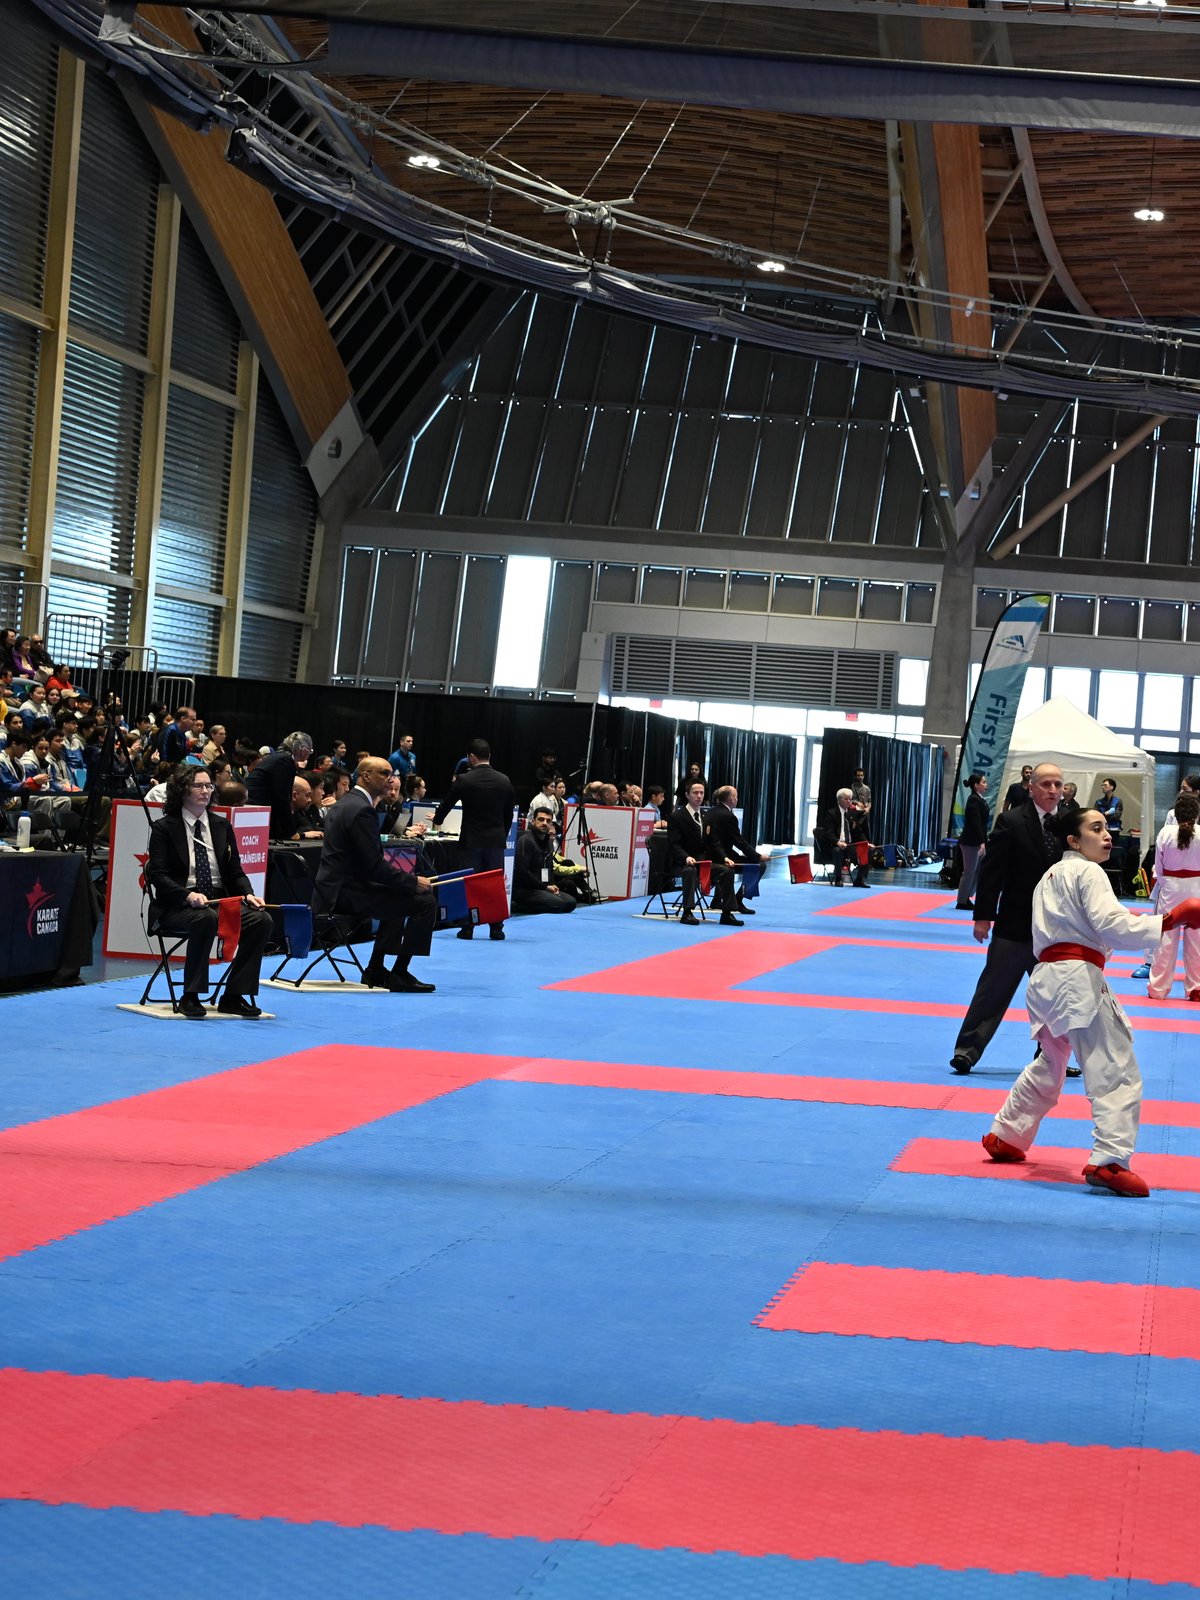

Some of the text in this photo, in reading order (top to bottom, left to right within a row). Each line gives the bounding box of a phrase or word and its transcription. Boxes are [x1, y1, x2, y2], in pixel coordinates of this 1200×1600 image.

[972, 693, 1007, 777] First Ai
[241, 836, 259, 846] COACH
[591, 845, 618, 853] KARATE
[591, 852, 618, 860] CANADA
[37, 908, 59, 921] KARATE
[36, 920, 58, 934] CANADA
